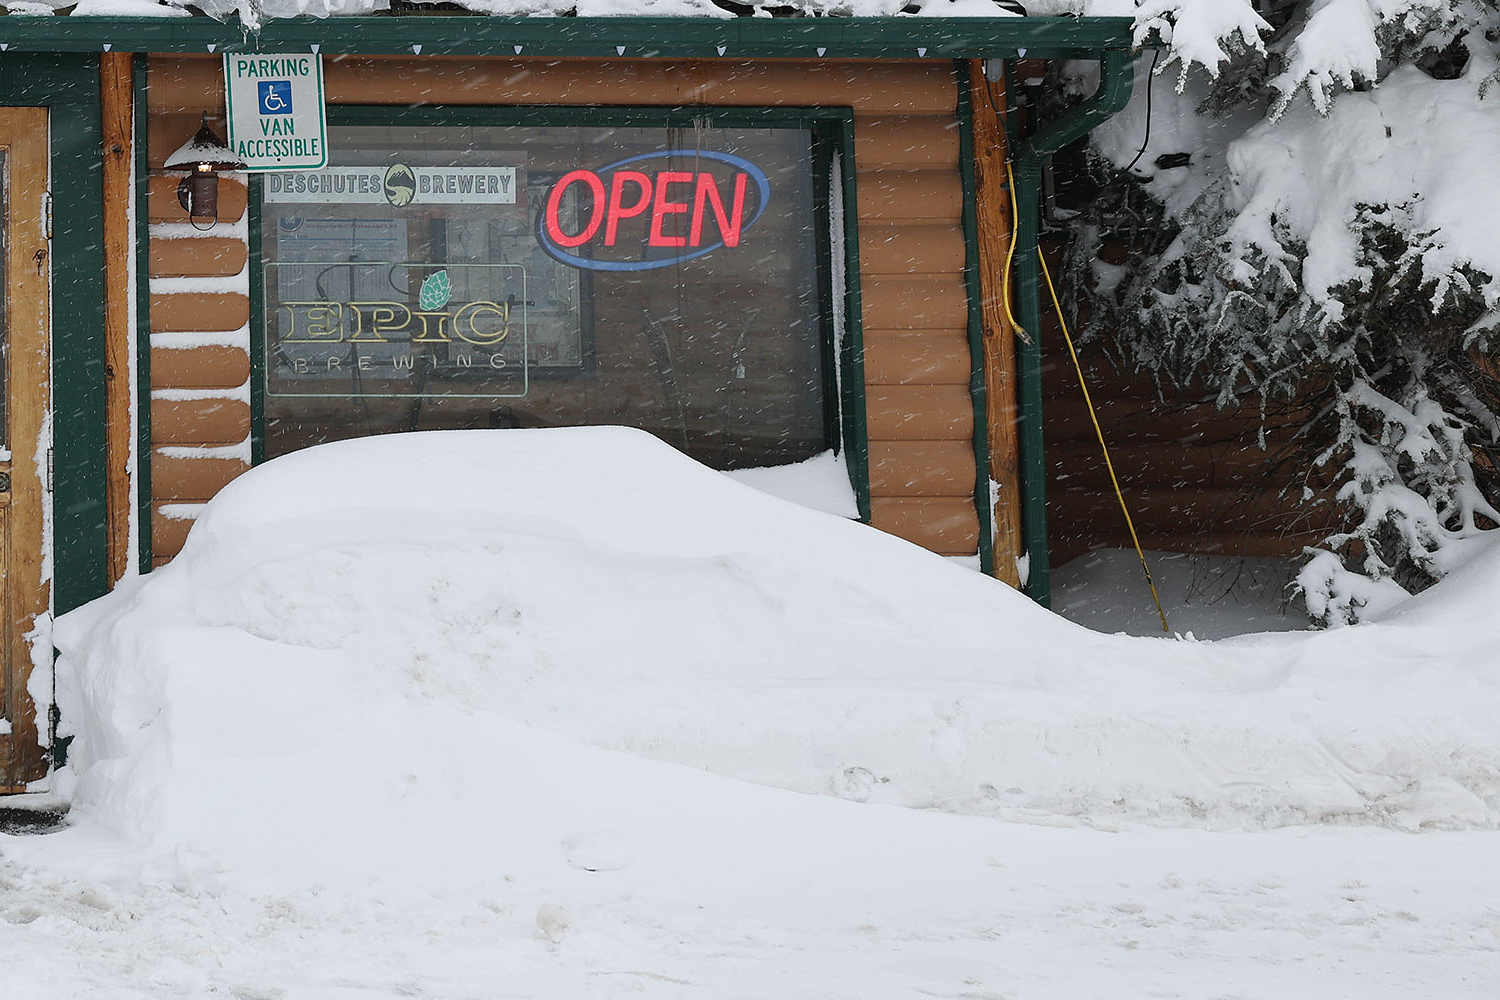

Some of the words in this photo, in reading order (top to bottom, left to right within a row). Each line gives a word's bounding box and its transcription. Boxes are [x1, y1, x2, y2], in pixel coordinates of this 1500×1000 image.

[238, 58, 310, 78] PARKING
[260, 118, 295, 136] VAN
[238, 138, 320, 158] ACCESSIBLE
[270, 174, 381, 194] DESCHUTES
[419, 174, 512, 194] BREWERY
[545, 169, 748, 248] OPEN
[294, 353, 507, 374] BREWING
